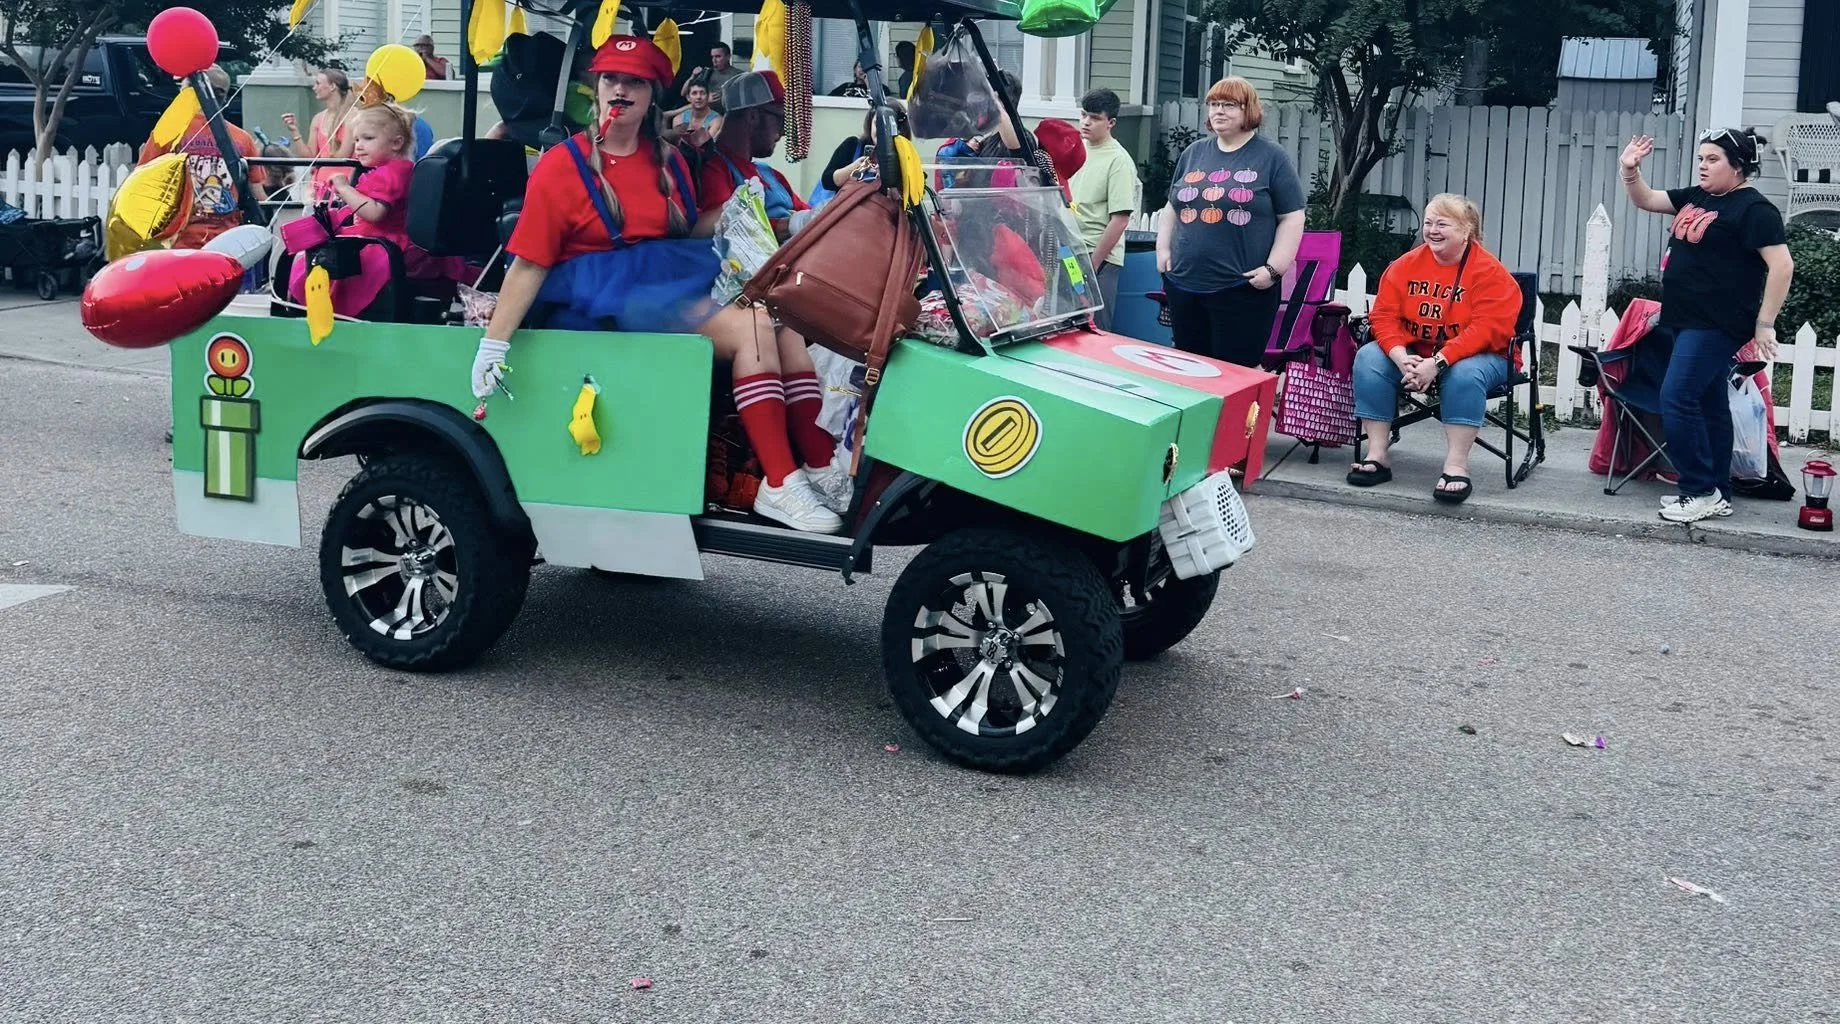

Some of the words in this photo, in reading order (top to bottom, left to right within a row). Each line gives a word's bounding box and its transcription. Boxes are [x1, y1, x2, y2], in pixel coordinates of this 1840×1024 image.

[1407, 280, 1466, 303] TRICK
[1418, 301, 1443, 320] OR
[1401, 317, 1460, 341] TREAT
